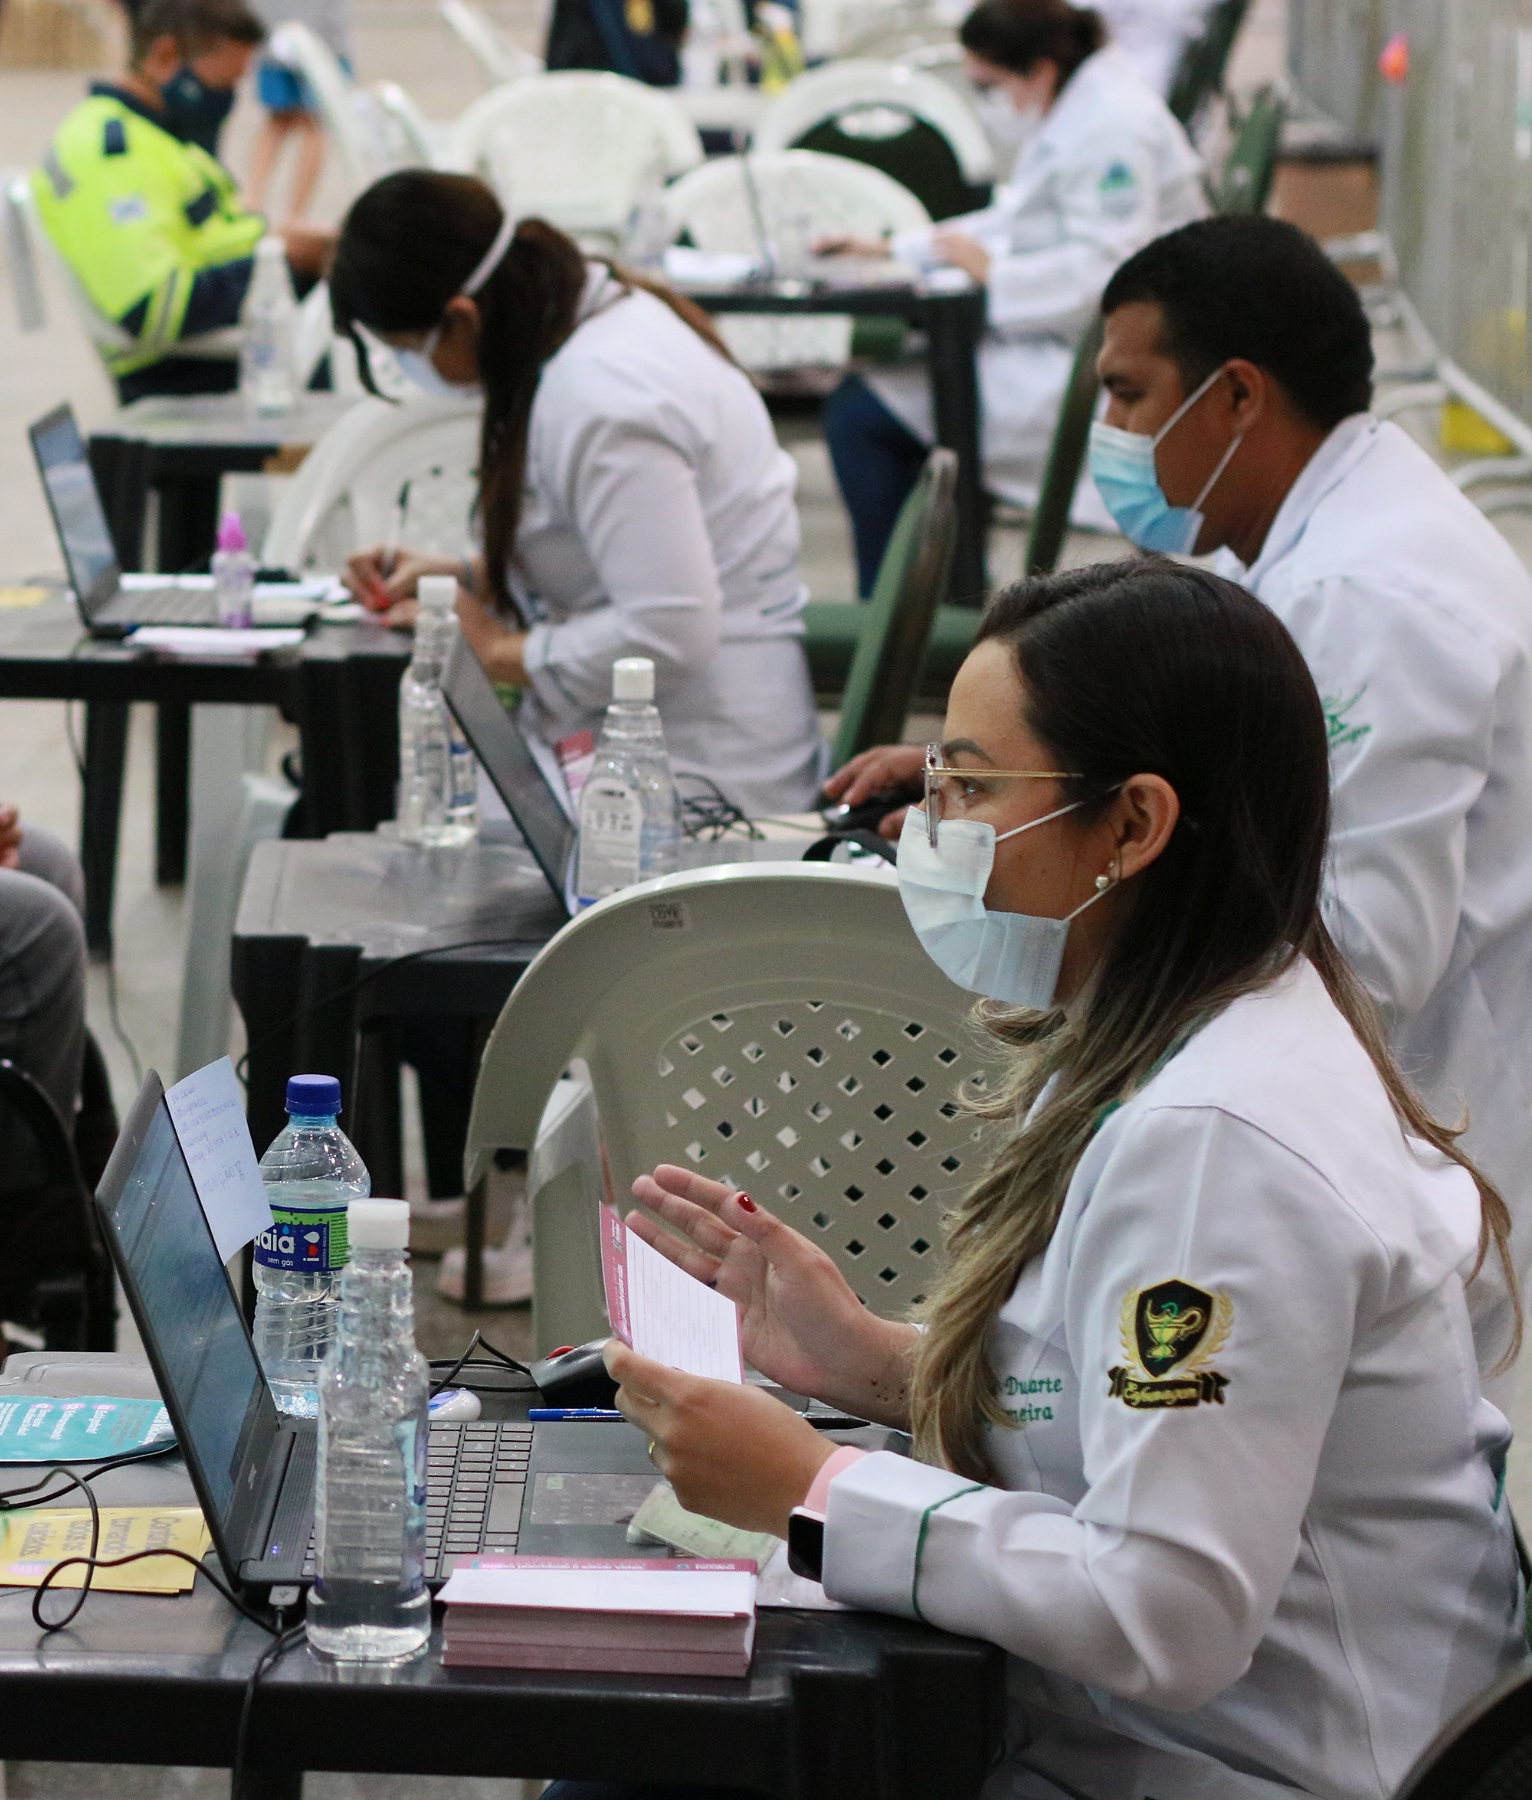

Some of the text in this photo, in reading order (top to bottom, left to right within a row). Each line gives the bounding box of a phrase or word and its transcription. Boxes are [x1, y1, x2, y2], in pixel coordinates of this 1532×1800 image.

[267, 1257, 294, 1268] sem gás
[1005, 1375, 1063, 1396] Duarte
